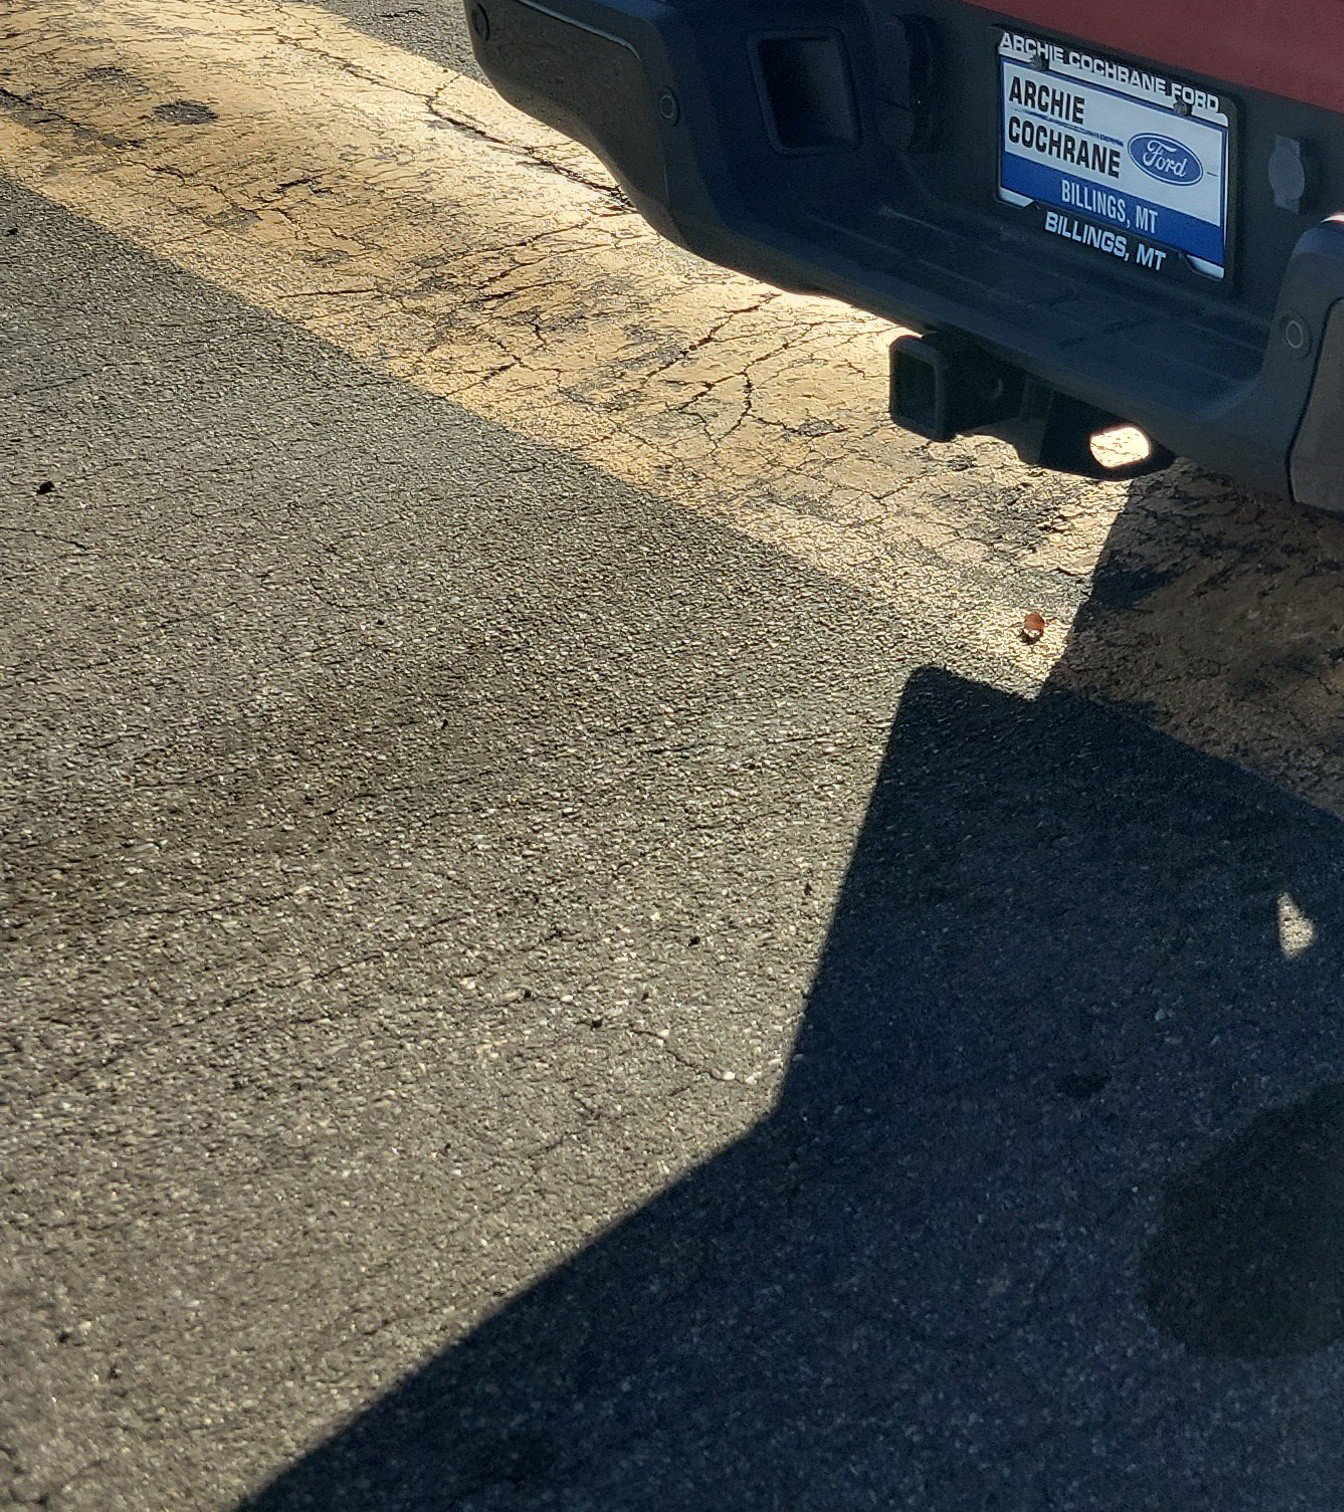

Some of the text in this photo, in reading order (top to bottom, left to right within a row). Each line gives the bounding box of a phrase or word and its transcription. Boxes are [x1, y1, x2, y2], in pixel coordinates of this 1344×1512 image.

[1000, 31, 1219, 113] ARCHIE COCHRANE FORD
[1009, 76, 1085, 125] ARCHIE
[1008, 116, 1121, 179] COCHRANE
[1142, 140, 1188, 178] Ford
[1061, 179, 1158, 234] BILLINGS, MT
[1045, 211, 1166, 271] BILLINGS, MT
